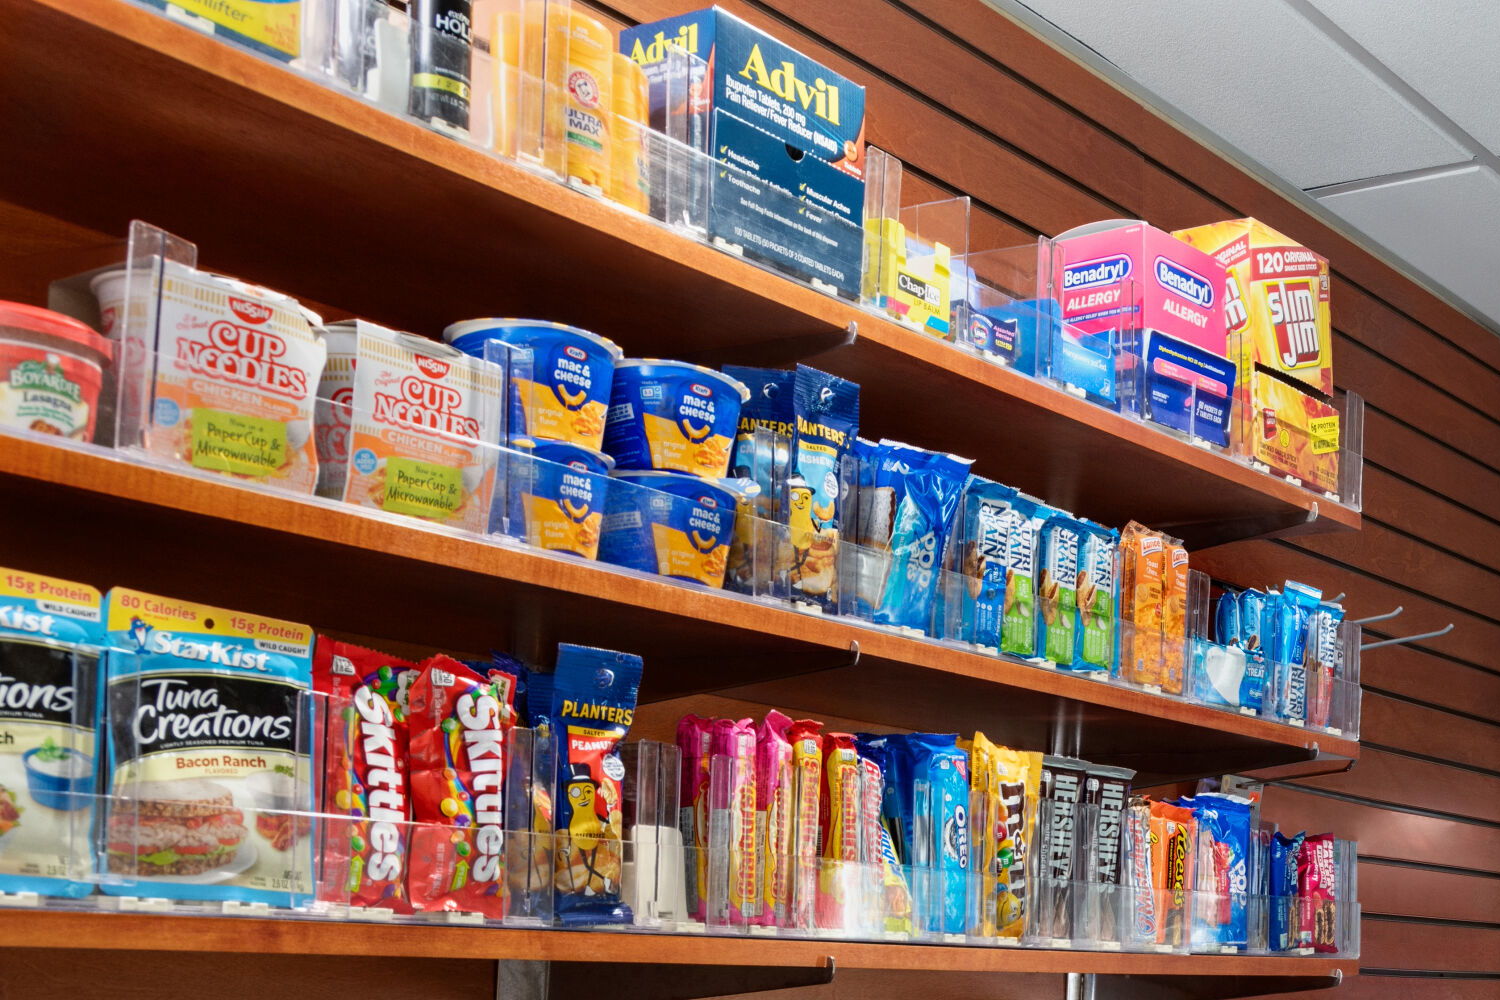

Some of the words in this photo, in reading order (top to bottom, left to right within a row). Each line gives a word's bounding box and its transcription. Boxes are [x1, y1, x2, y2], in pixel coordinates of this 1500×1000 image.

[630, 23, 698, 66] Advil
[739, 44, 840, 126] Advil
[569, 118, 599, 136] MAX
[1065, 260, 1123, 287] Benadryl
[1257, 251, 1284, 274] 120
[1284, 251, 1317, 263] ORIGINAL
[1160, 263, 1208, 302] Benadryl
[232, 302, 270, 320] NISSIN
[923, 301, 941, 315] BALM
[1067, 289, 1121, 312] ALLERGY
[1163, 299, 1208, 328] ALLERGY
[208, 320, 287, 360] CUP
[176, 337, 308, 401] NOODLES
[417, 358, 447, 375] NISSIN
[554, 369, 593, 389] cheese
[558, 357, 581, 375] mac
[581, 363, 591, 377] &
[10, 369, 81, 397] BOYARDEE
[191, 381, 263, 408] CHICKEN
[401, 375, 461, 413] CUP
[679, 405, 715, 424] cheese
[683, 394, 707, 411] mac
[707, 402, 715, 413] &
[373, 392, 481, 448] NOODLES
[206, 422, 243, 444] Paper
[243, 431, 269, 452] Cup
[387, 432, 444, 455] CHICKEN
[195, 443, 277, 470] Microwavable
[398, 470, 426, 489] Paper
[426, 477, 447, 496] Cup
[560, 483, 592, 503] cheese
[562, 473, 583, 490] mac
[386, 487, 454, 513] Microwavable
[692, 506, 712, 522] mac
[689, 516, 721, 535] cheese
[981, 501, 998, 559] GRAIN
[991, 503, 1009, 561] NUTRI
[919, 531, 935, 588] pop
[1057, 528, 1069, 586] GRAIN
[1066, 532, 1079, 586] NUTRI
[1142, 540, 1161, 551] Lance
[1173, 551, 1187, 563] Lance
[6, 575, 35, 594] 15g
[39, 581, 92, 603] Protein
[121, 595, 140, 609] 80
[144, 598, 197, 622] Calories
[230, 616, 255, 635] 15g
[258, 623, 304, 642] Protein
[153, 631, 271, 673] StarKist
[279, 643, 306, 656] CAUGHT
[141, 678, 218, 713] Tuna
[133, 704, 291, 746] Creations
[562, 699, 633, 727] PLANTERS
[176, 755, 219, 770] Bacon
[223, 754, 267, 770] Ranch
[954, 804, 968, 870] OREO
[1049, 774, 1078, 889] HERSHEY'S
[1098, 783, 1125, 894] HERSHEY'S
[1173, 823, 1192, 908] Reese's
